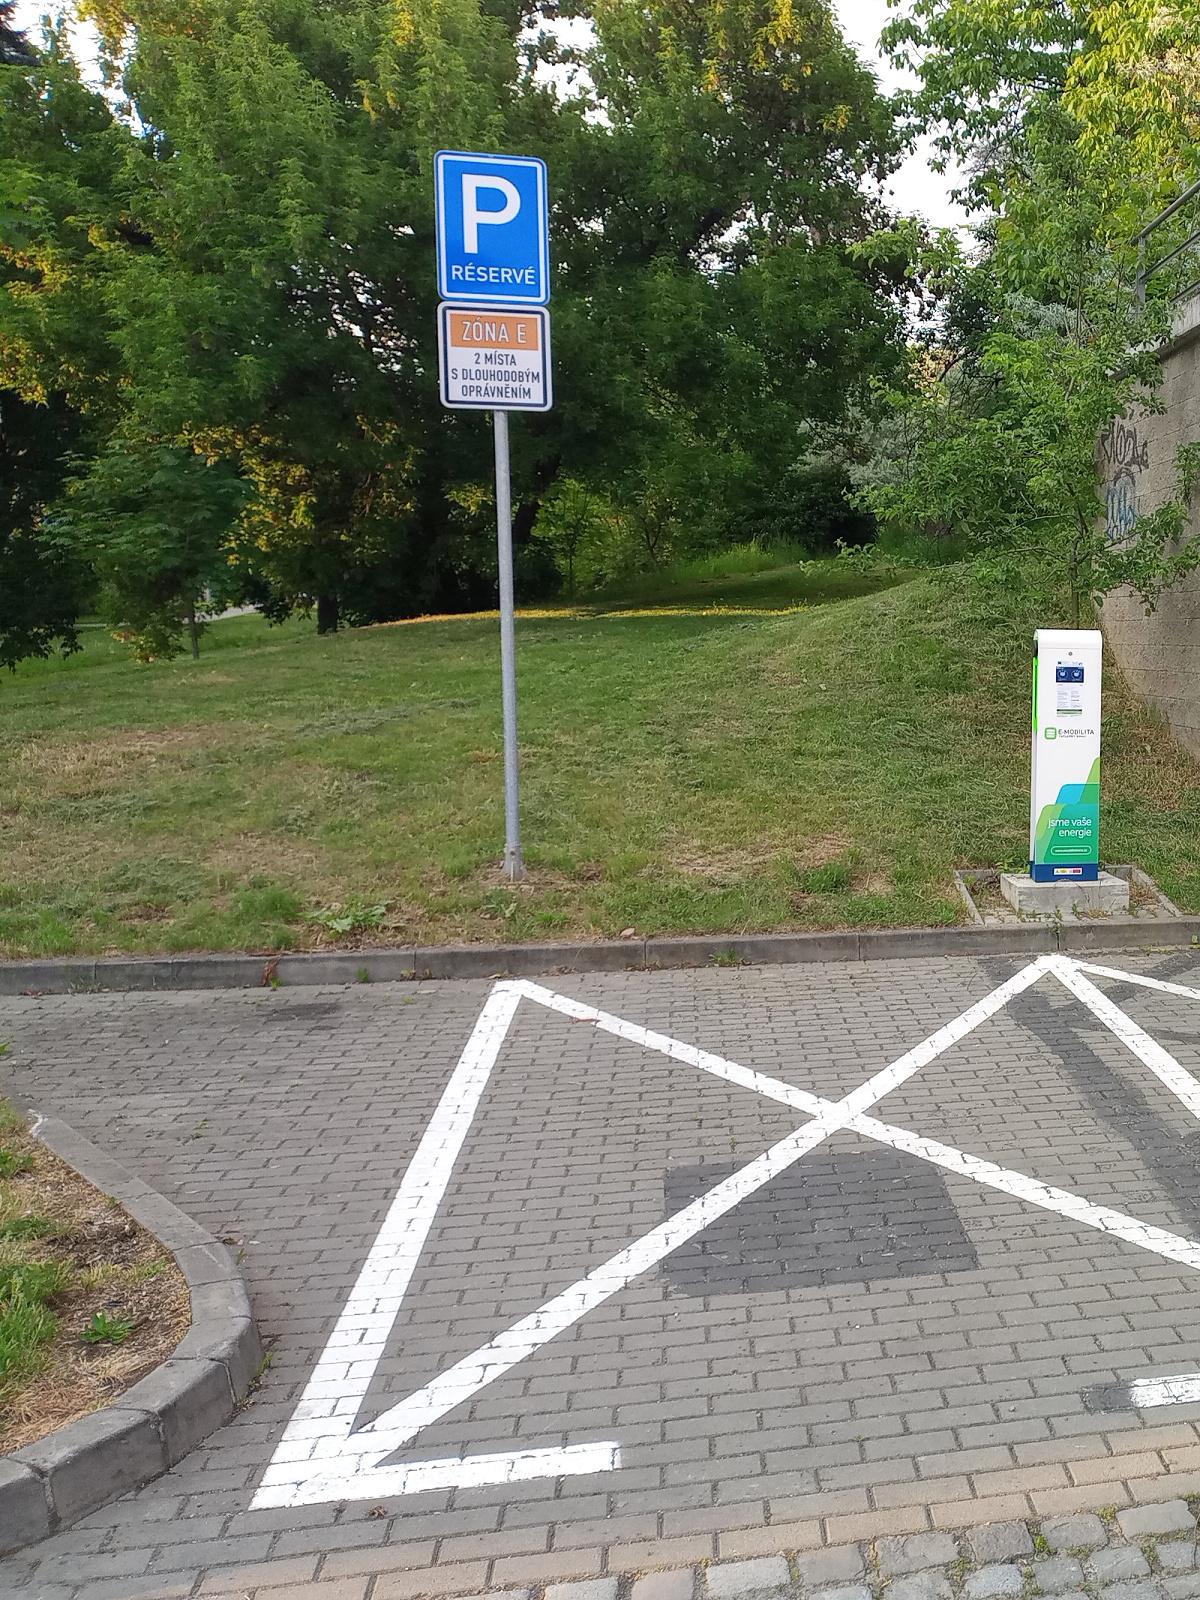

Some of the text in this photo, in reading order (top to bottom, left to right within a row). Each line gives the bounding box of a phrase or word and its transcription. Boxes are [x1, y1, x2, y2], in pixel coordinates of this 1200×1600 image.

[462, 173, 521, 254] P
[451, 263, 536, 285] RÉSERVÉ
[462, 317, 527, 344] ZÓNA E
[474, 351, 517, 366] 2 MÍSTA
[451, 368, 540, 383] S DLOUHODOBÝM
[462, 383, 531, 399] OPRÁVNĚNÍM
[1048, 816, 1092, 829] jsme vaše
[1059, 828, 1092, 839] energie
